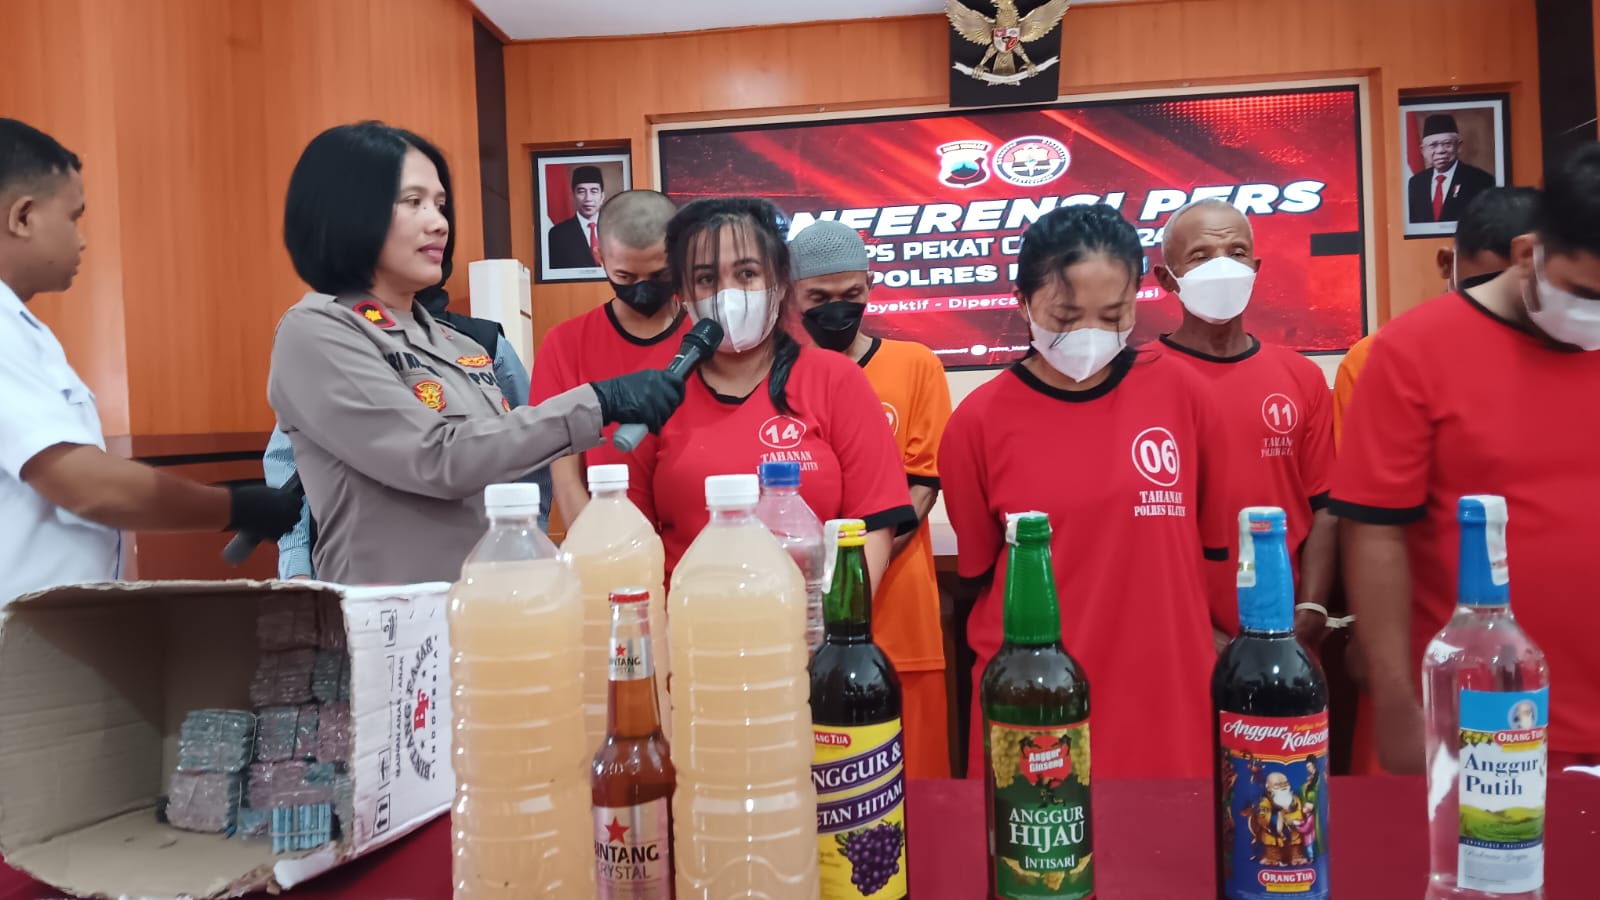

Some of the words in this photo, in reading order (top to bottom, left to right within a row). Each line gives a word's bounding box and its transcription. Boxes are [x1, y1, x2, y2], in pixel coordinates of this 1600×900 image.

[784, 190, 1126, 242] NFERENI
[864, 243, 896, 262] PS
[902, 236, 995, 261] PEKAT
[866, 299, 929, 313] byektif
[949, 296, 1019, 309] Diperca
[1268, 402, 1292, 427] 11
[765, 423, 800, 444] 14
[760, 450, 813, 463] TAHANAN
[799, 461, 819, 472] LATEN
[1139, 439, 1177, 475] 06
[1133, 505, 1166, 517] POLRES
[405, 636, 434, 697] FAJAR
[815, 734, 830, 744] ANG
[831, 733, 849, 745] TUA
[1223, 719, 1289, 743] Anggur
[1497, 732, 1531, 743] ORANG
[404, 703, 432, 782] BINTANG
[812, 751, 889, 788] NGGUR
[891, 741, 902, 763] &
[1028, 747, 1062, 763] Anggur
[1029, 757, 1064, 774] Ginseng
[1464, 752, 1539, 777] Anggur
[1465, 774, 1523, 796] Putih
[816, 806, 852, 827] ETAN
[857, 779, 903, 819] HITAM
[1008, 805, 1085, 825] ANGGUR
[1009, 820, 1085, 853] HIJAU
[1025, 854, 1076, 869] INTISARI
[1261, 872, 1296, 883] ORANG
[1296, 871, 1313, 882] TUA
